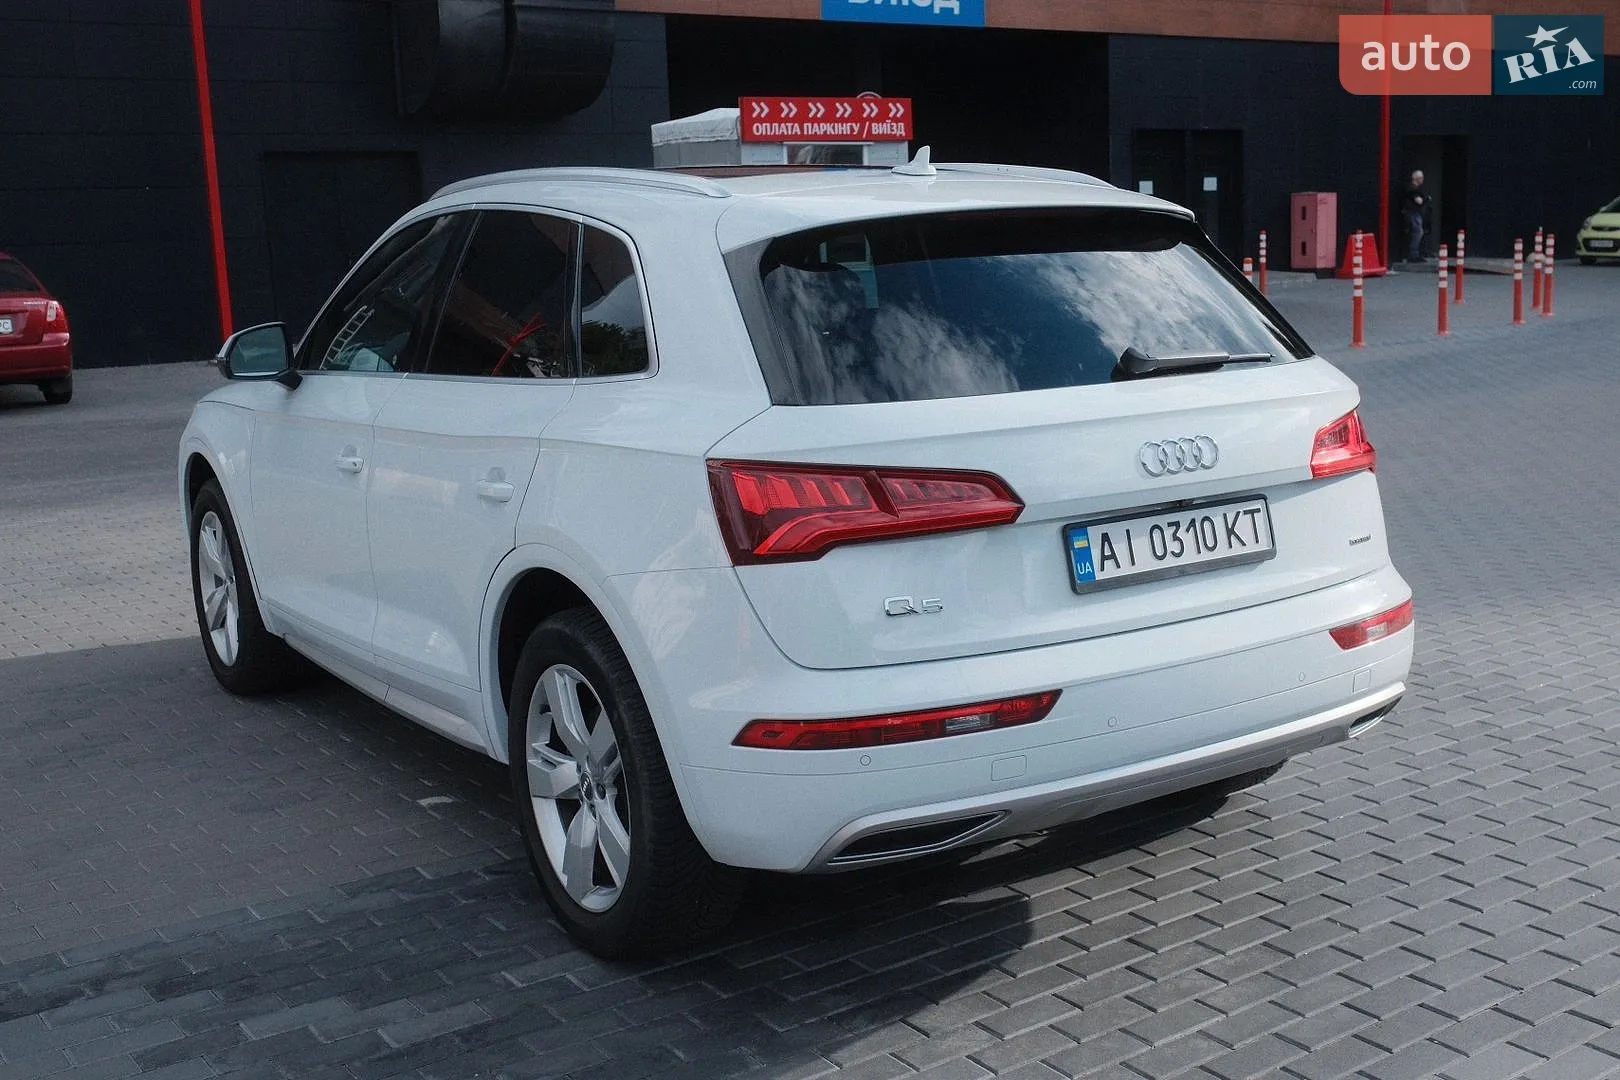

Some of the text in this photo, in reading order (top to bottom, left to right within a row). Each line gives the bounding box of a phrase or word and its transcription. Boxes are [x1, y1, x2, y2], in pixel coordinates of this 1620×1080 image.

[752, 122, 800, 136] ОПЛАТА
[803, 122, 860, 136] ПАРКІНГУ
[871, 120, 906, 137] ВИЇЗД
[1100, 507, 1262, 572] AI 0310 KT
[1077, 562, 1093, 576] UA
[884, 596, 943, 616] Q5
